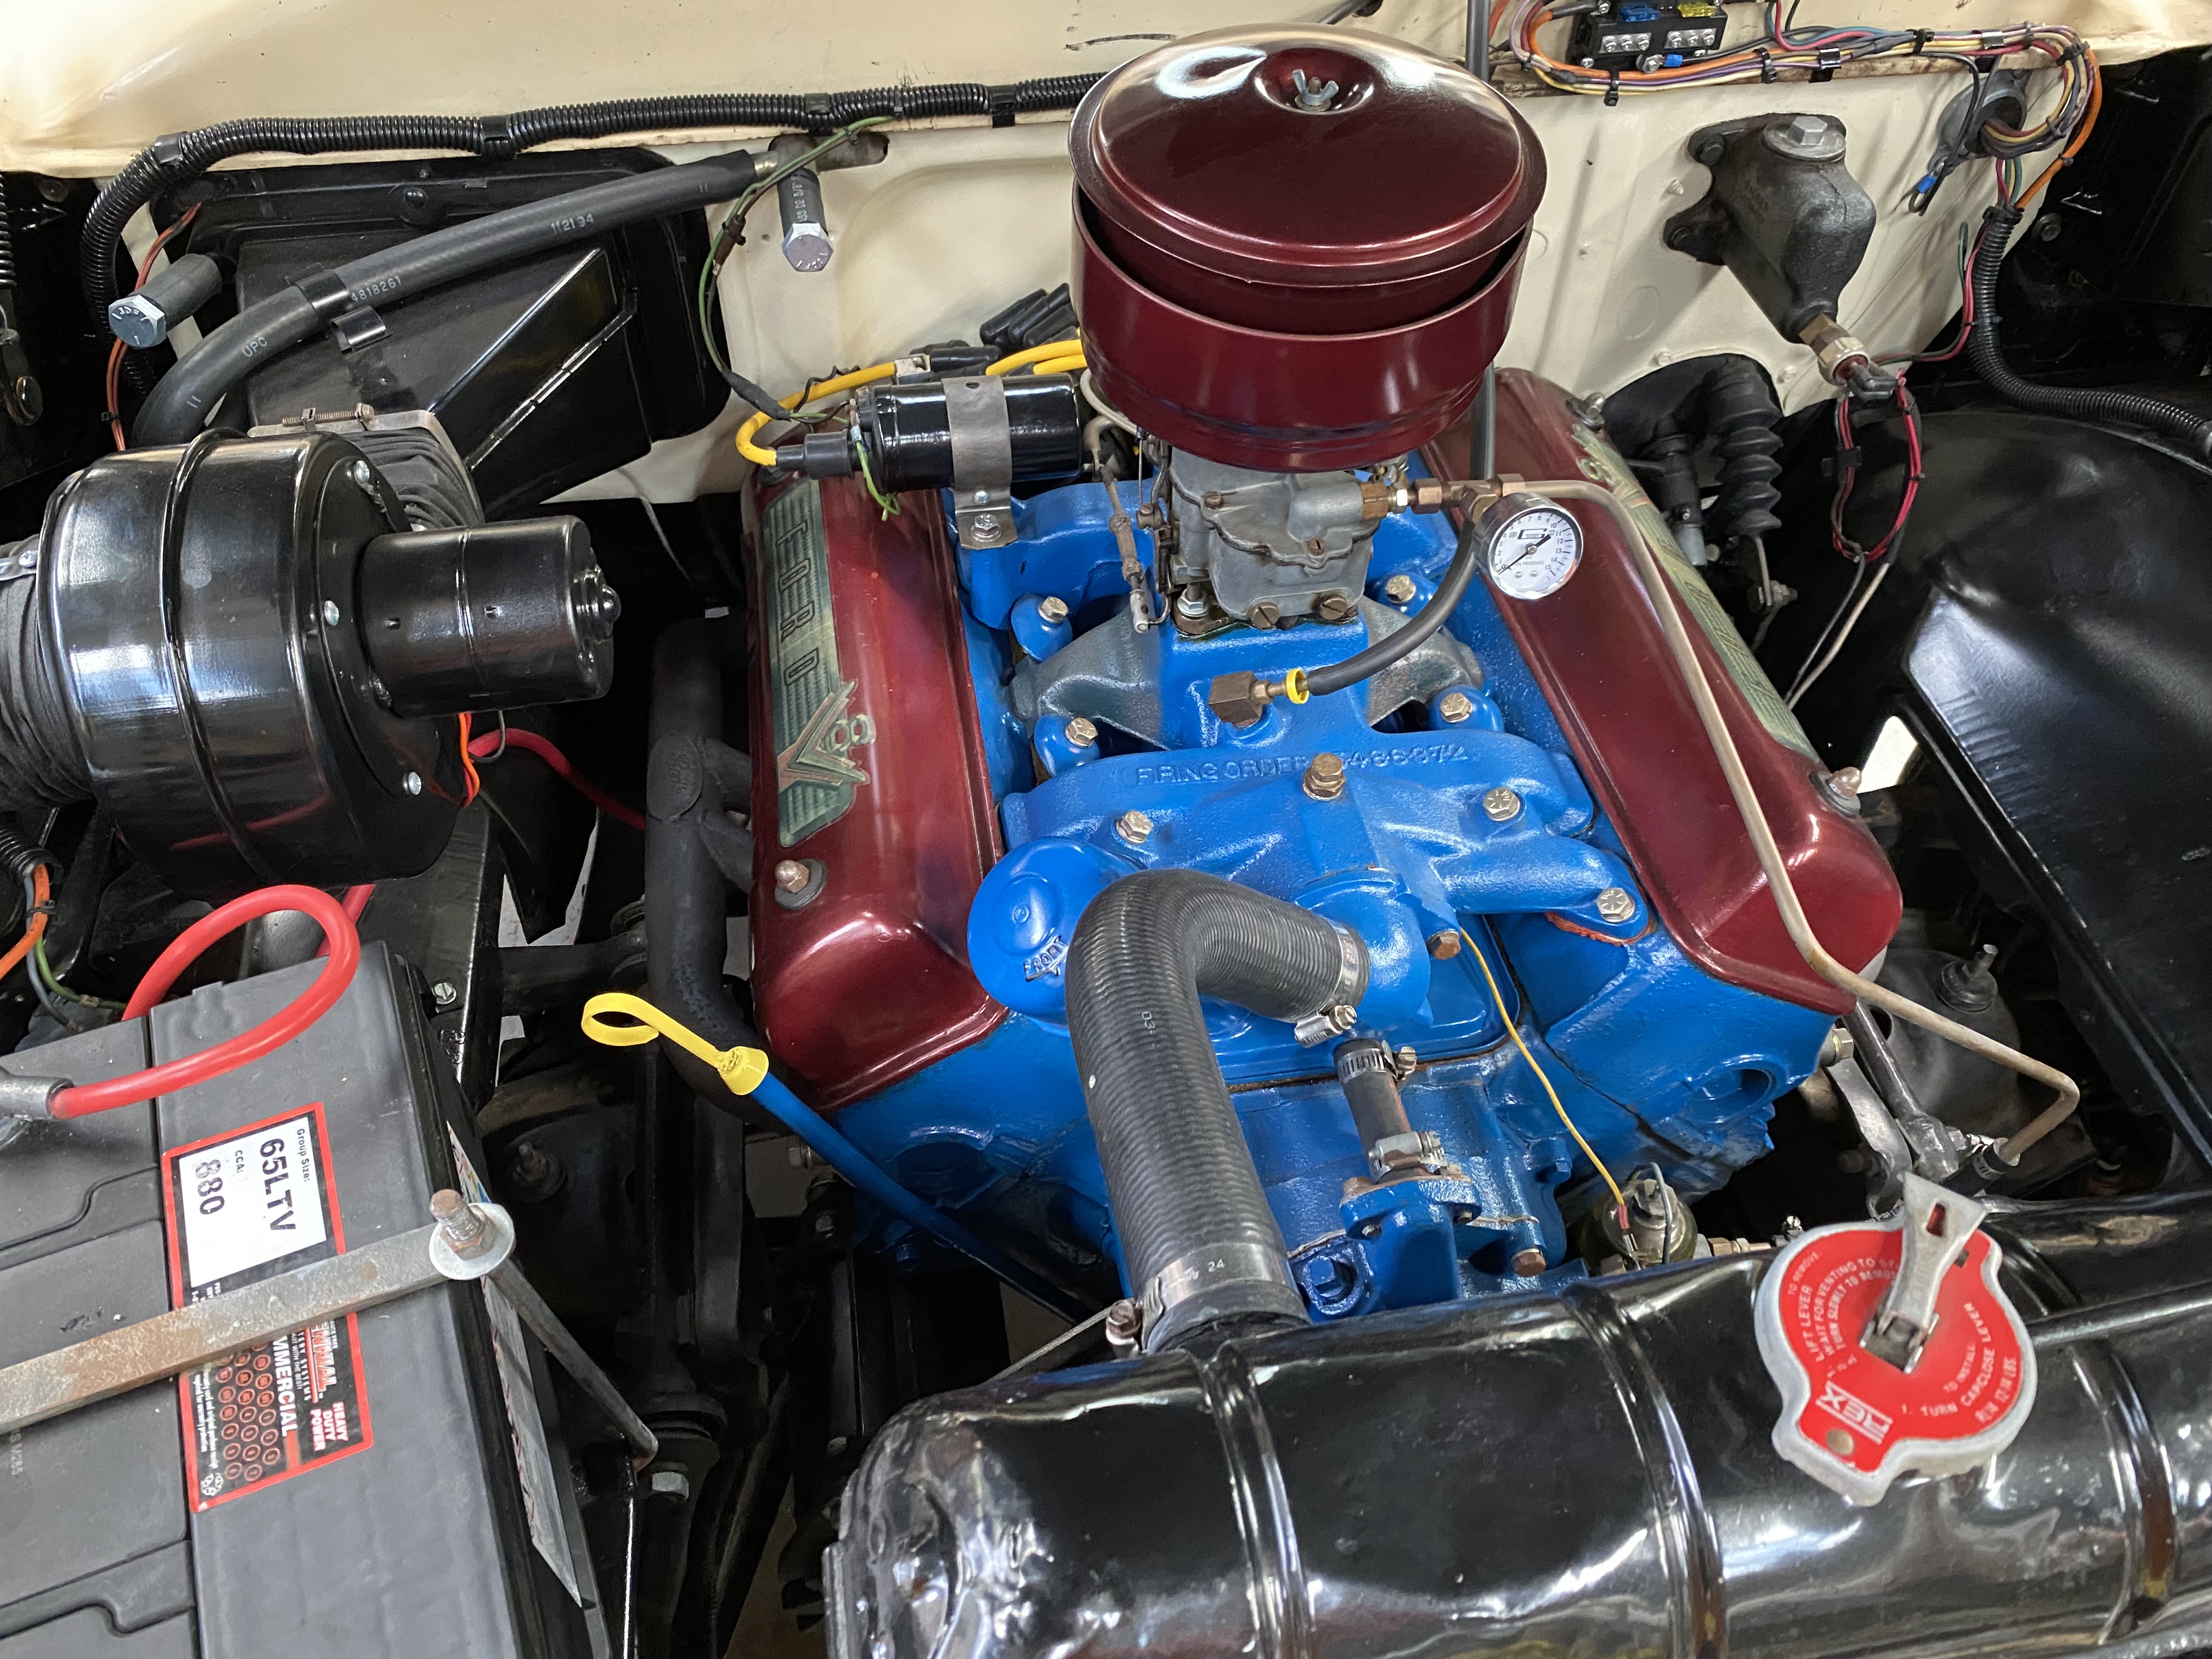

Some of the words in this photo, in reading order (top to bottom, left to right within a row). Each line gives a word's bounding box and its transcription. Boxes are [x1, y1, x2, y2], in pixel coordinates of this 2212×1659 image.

[351, 275, 402, 302] 4818261
[241, 337, 267, 357] UPC
[775, 519, 820, 687] FORD
[1137, 763, 1219, 785] FIRING
[1023, 935, 1068, 975] FRONT
[297, 1128, 306, 1156] Group
[260, 1138, 296, 1231] 65LTV
[301, 1158, 311, 1182] Size:
[195, 1159, 225, 1215] 880
[1208, 1259, 1225, 1272] 24
[1858, 1257, 1875, 1267] TO
[1818, 1261, 1858, 1297] VENTING
[1844, 1276, 1859, 1287] TO
[1798, 1285, 1813, 1327] LEVER
[1814, 1298, 1825, 1322] FOR
[1803, 1331, 1825, 1363] LIFT
[1815, 1324, 1835, 1356] WAIT
[1920, 1402, 1959, 1418] TURN
[1964, 1301, 1992, 1344] LEVER
[310, 1409, 326, 1451] POWER
[323, 1410, 336, 1440] DUTY
[332, 1402, 348, 1441] HEAVY
